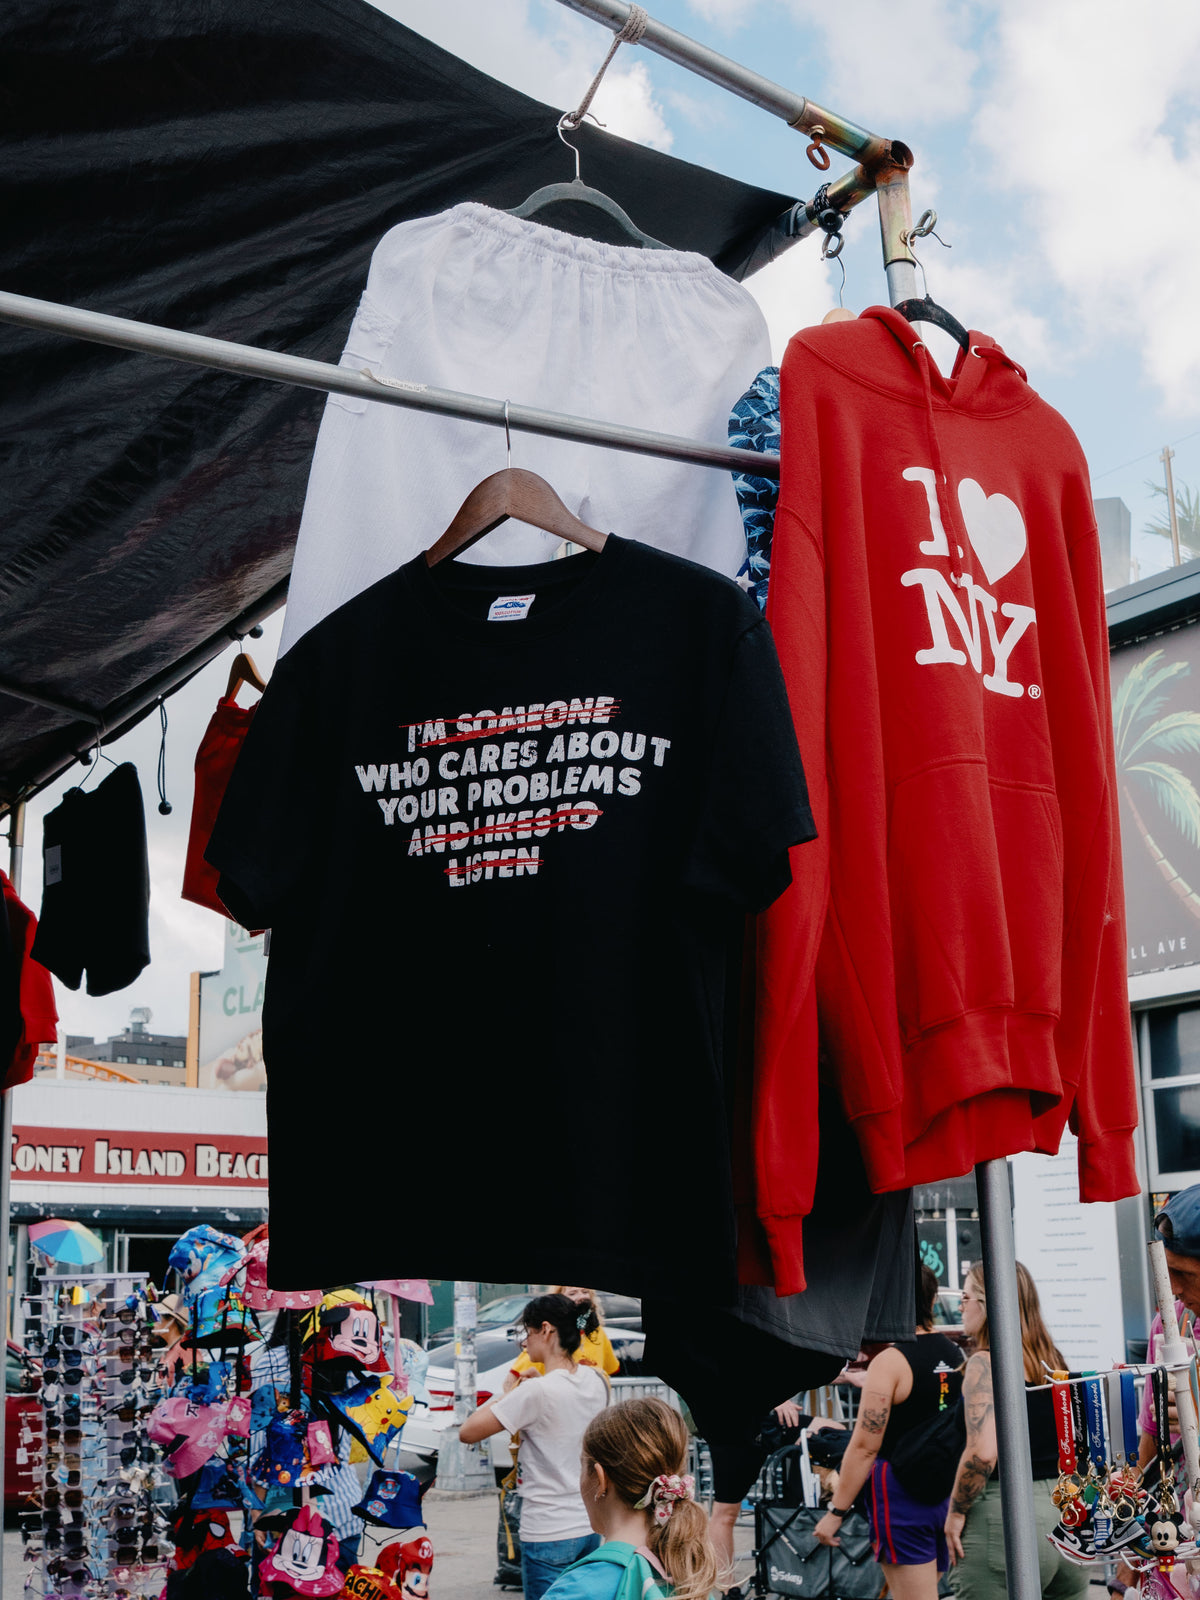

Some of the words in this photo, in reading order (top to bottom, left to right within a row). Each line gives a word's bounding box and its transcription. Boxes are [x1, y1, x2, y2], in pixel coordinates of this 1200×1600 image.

[408, 718, 447, 752] I'M
[456, 696, 614, 738] SOMEONE
[355, 758, 429, 792] WHO
[439, 740, 538, 780] CARES
[546, 731, 671, 766] ABOUT
[377, 787, 460, 825] YOUR
[468, 765, 642, 811] PROBLEMS
[408, 821, 470, 856] AND
[473, 807, 552, 846] LIKES
[557, 801, 599, 832] TO
[448, 846, 539, 887] LISTEN
[1158, 937, 1187, 955] AVE
[94, 1139, 186, 1176] ISLAND
[1073, 1382, 1082, 1404] sport
